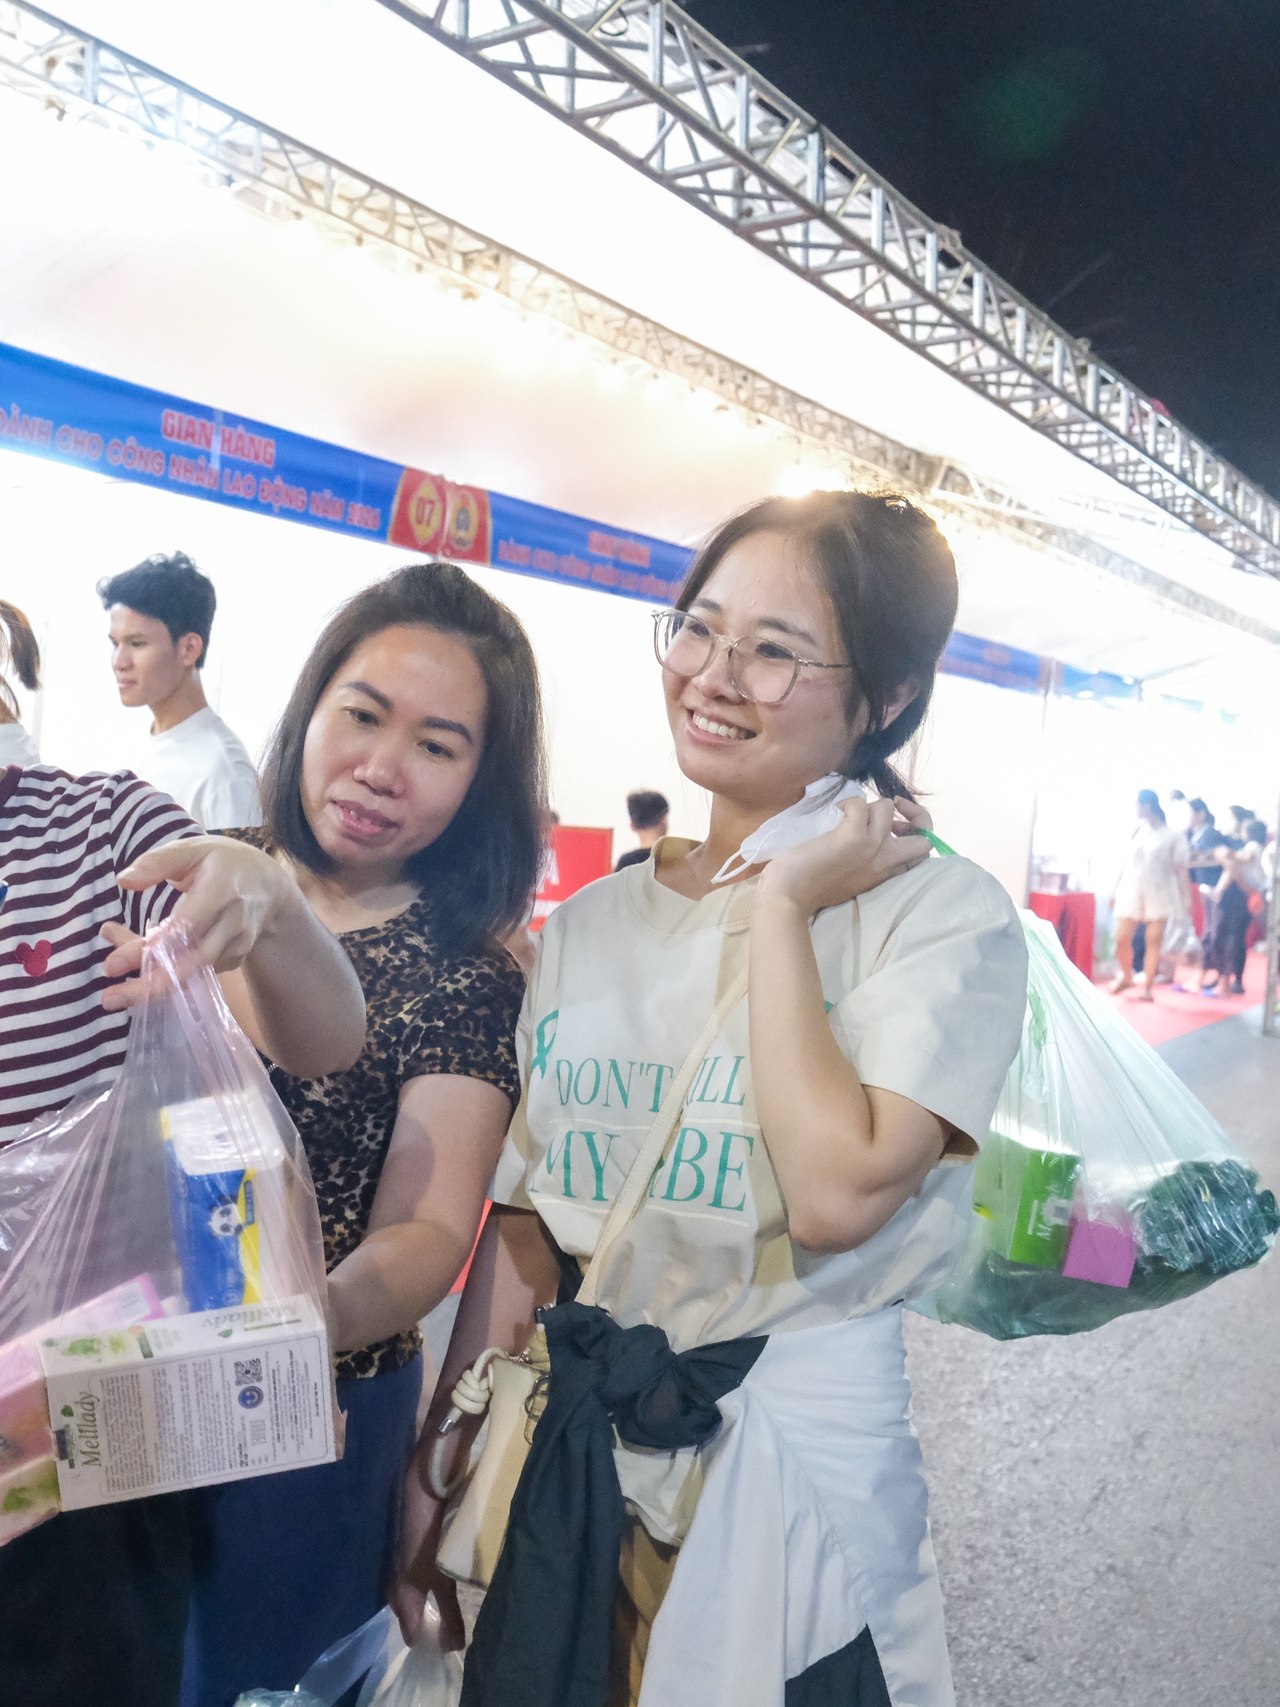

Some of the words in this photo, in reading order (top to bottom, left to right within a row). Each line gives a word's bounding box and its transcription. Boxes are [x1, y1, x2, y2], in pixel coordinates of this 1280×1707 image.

[56, 424, 104, 461] CHO
[107, 436, 165, 476] CÔNG
[169, 454, 219, 490] NHÂN
[223, 468, 257, 499] LAO
[258, 475, 308, 513] ĐỘNG
[161, 408, 216, 451] GIAN
[220, 424, 275, 468] HÀNG
[416, 497, 434, 527] 07
[556, 1057, 674, 1113] DON'T
[686, 1055, 745, 1106] ILL
[528, 1129, 621, 1202] MY
[74, 1390, 101, 1468] Melilady
